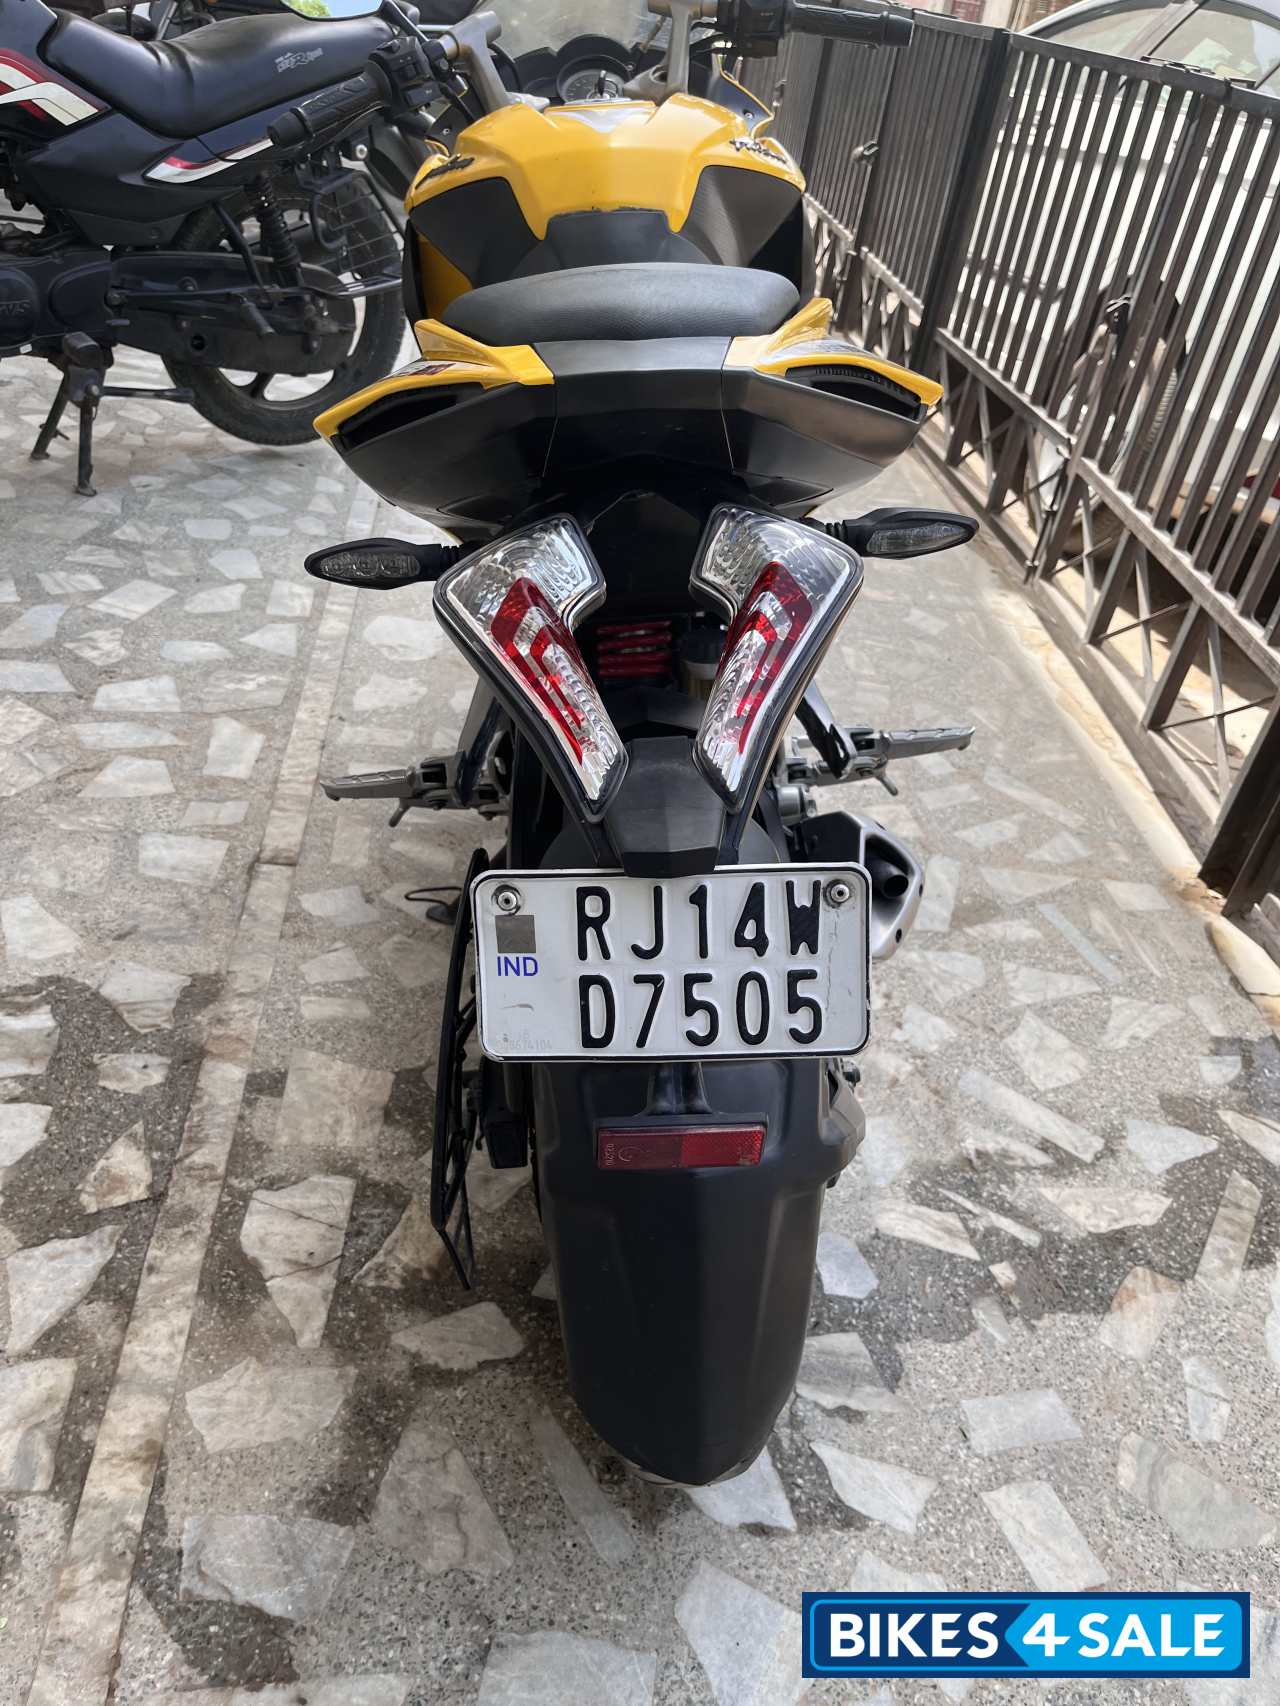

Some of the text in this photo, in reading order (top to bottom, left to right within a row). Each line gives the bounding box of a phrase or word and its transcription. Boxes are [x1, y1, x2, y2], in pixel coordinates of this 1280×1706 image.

[576, 881, 823, 961] RJ14W
[497, 956, 538, 976] IND
[579, 969, 822, 1049] D7505
